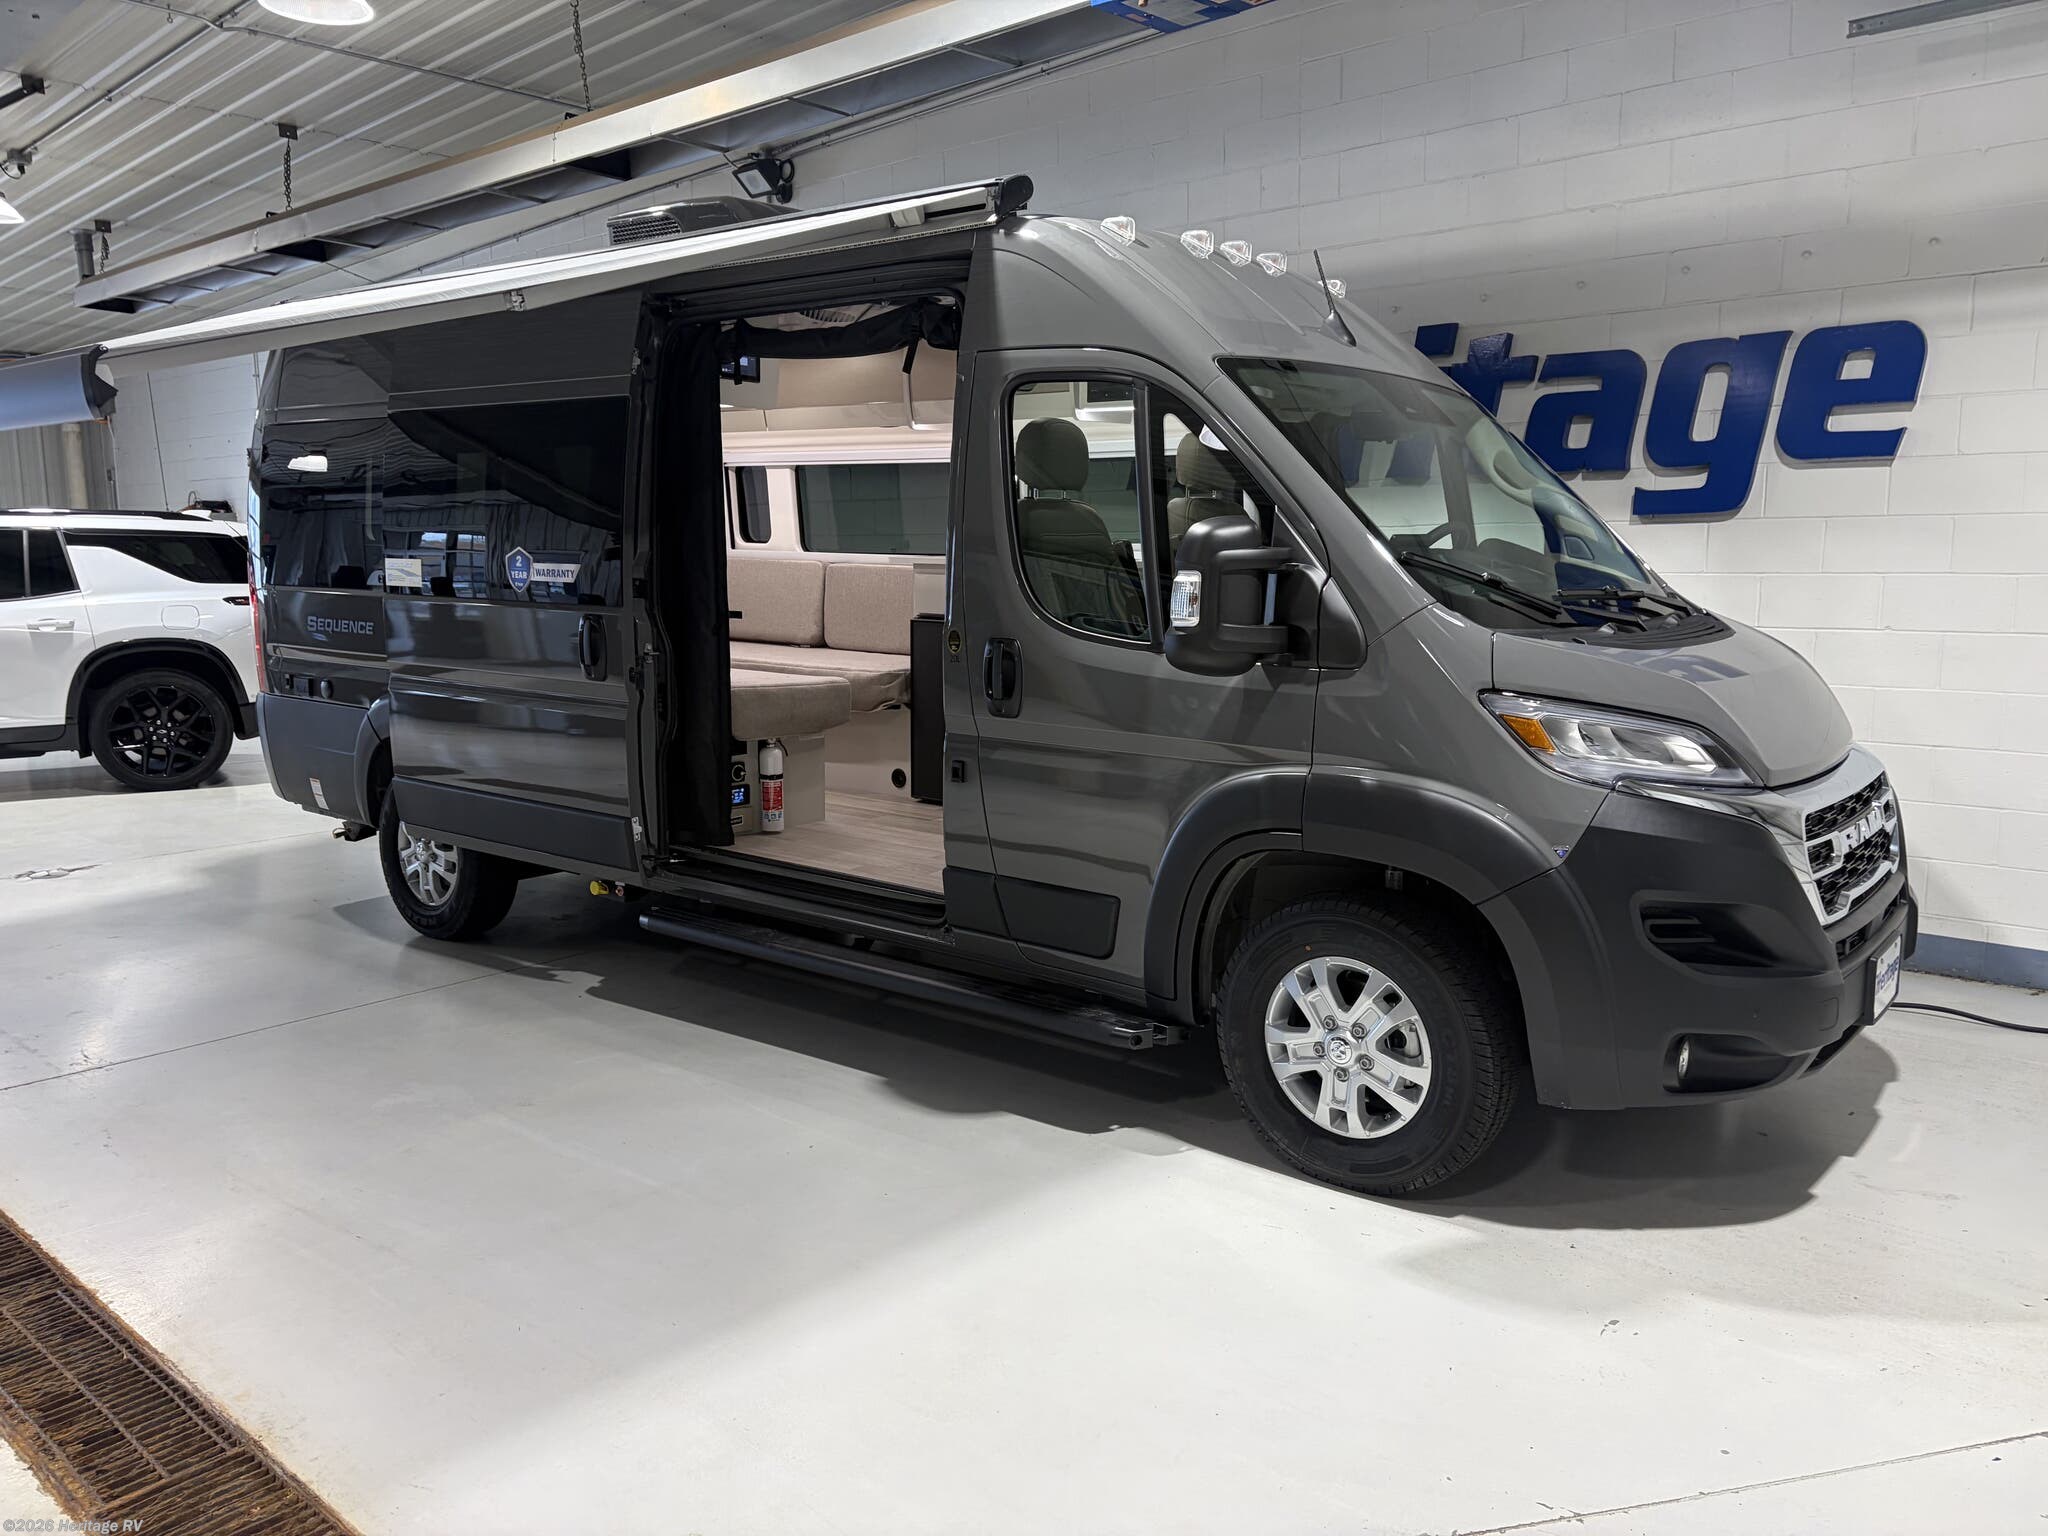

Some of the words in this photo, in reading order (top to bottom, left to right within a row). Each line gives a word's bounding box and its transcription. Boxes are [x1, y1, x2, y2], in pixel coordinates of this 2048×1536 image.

[515, 555, 522, 567] 2
[510, 570, 528, 579] YEAR
[535, 568, 575, 579] WARRANTY
[1841, 801, 1885, 852] RAM
